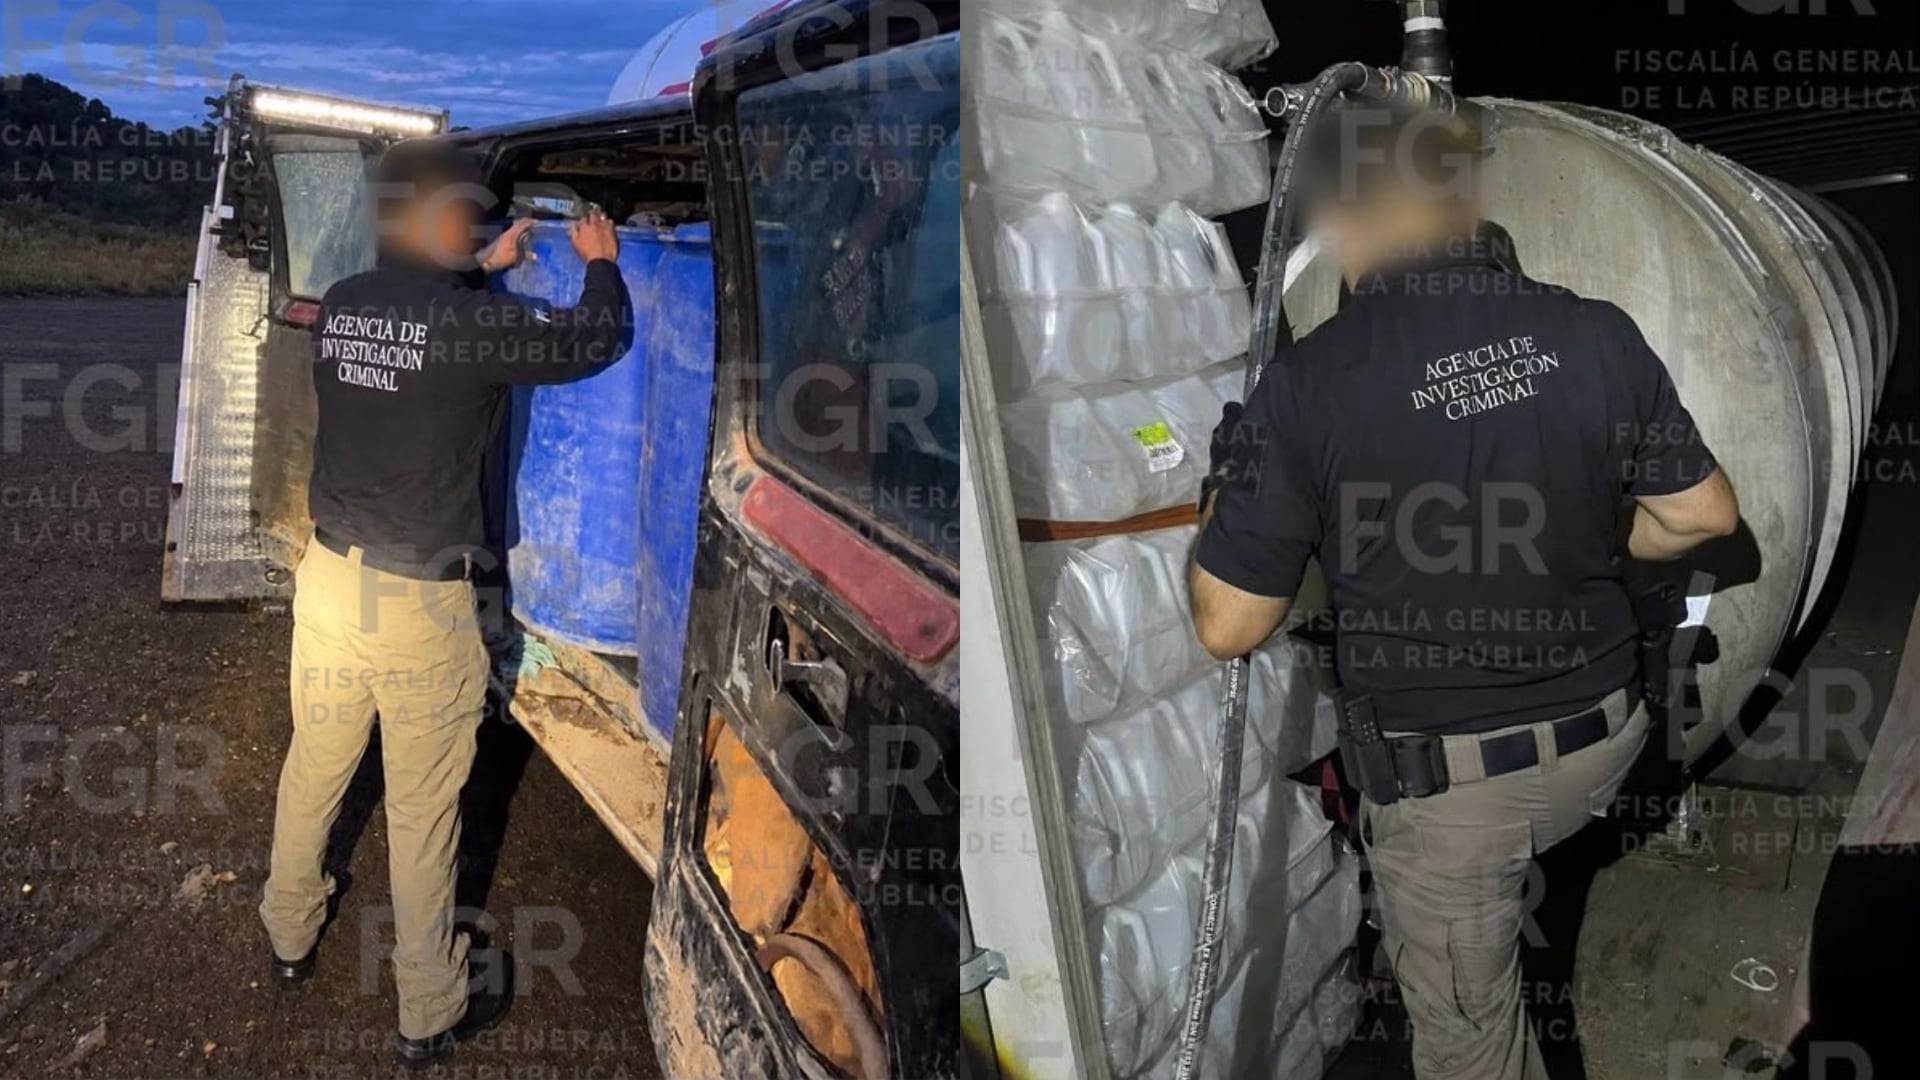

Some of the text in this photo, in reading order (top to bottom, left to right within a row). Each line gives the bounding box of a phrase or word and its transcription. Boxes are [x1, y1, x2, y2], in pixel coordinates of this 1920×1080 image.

[322, 315, 428, 344] AGENCIA DE
[321, 337, 424, 371] INVESTIGACIÓN
[1425, 336, 1537, 381] AGENCIA DE
[338, 361, 399, 392] CRIMINAL
[1411, 352, 1560, 410] INVESTIGACIÓN
[1446, 379, 1538, 420] CRIMINAL
